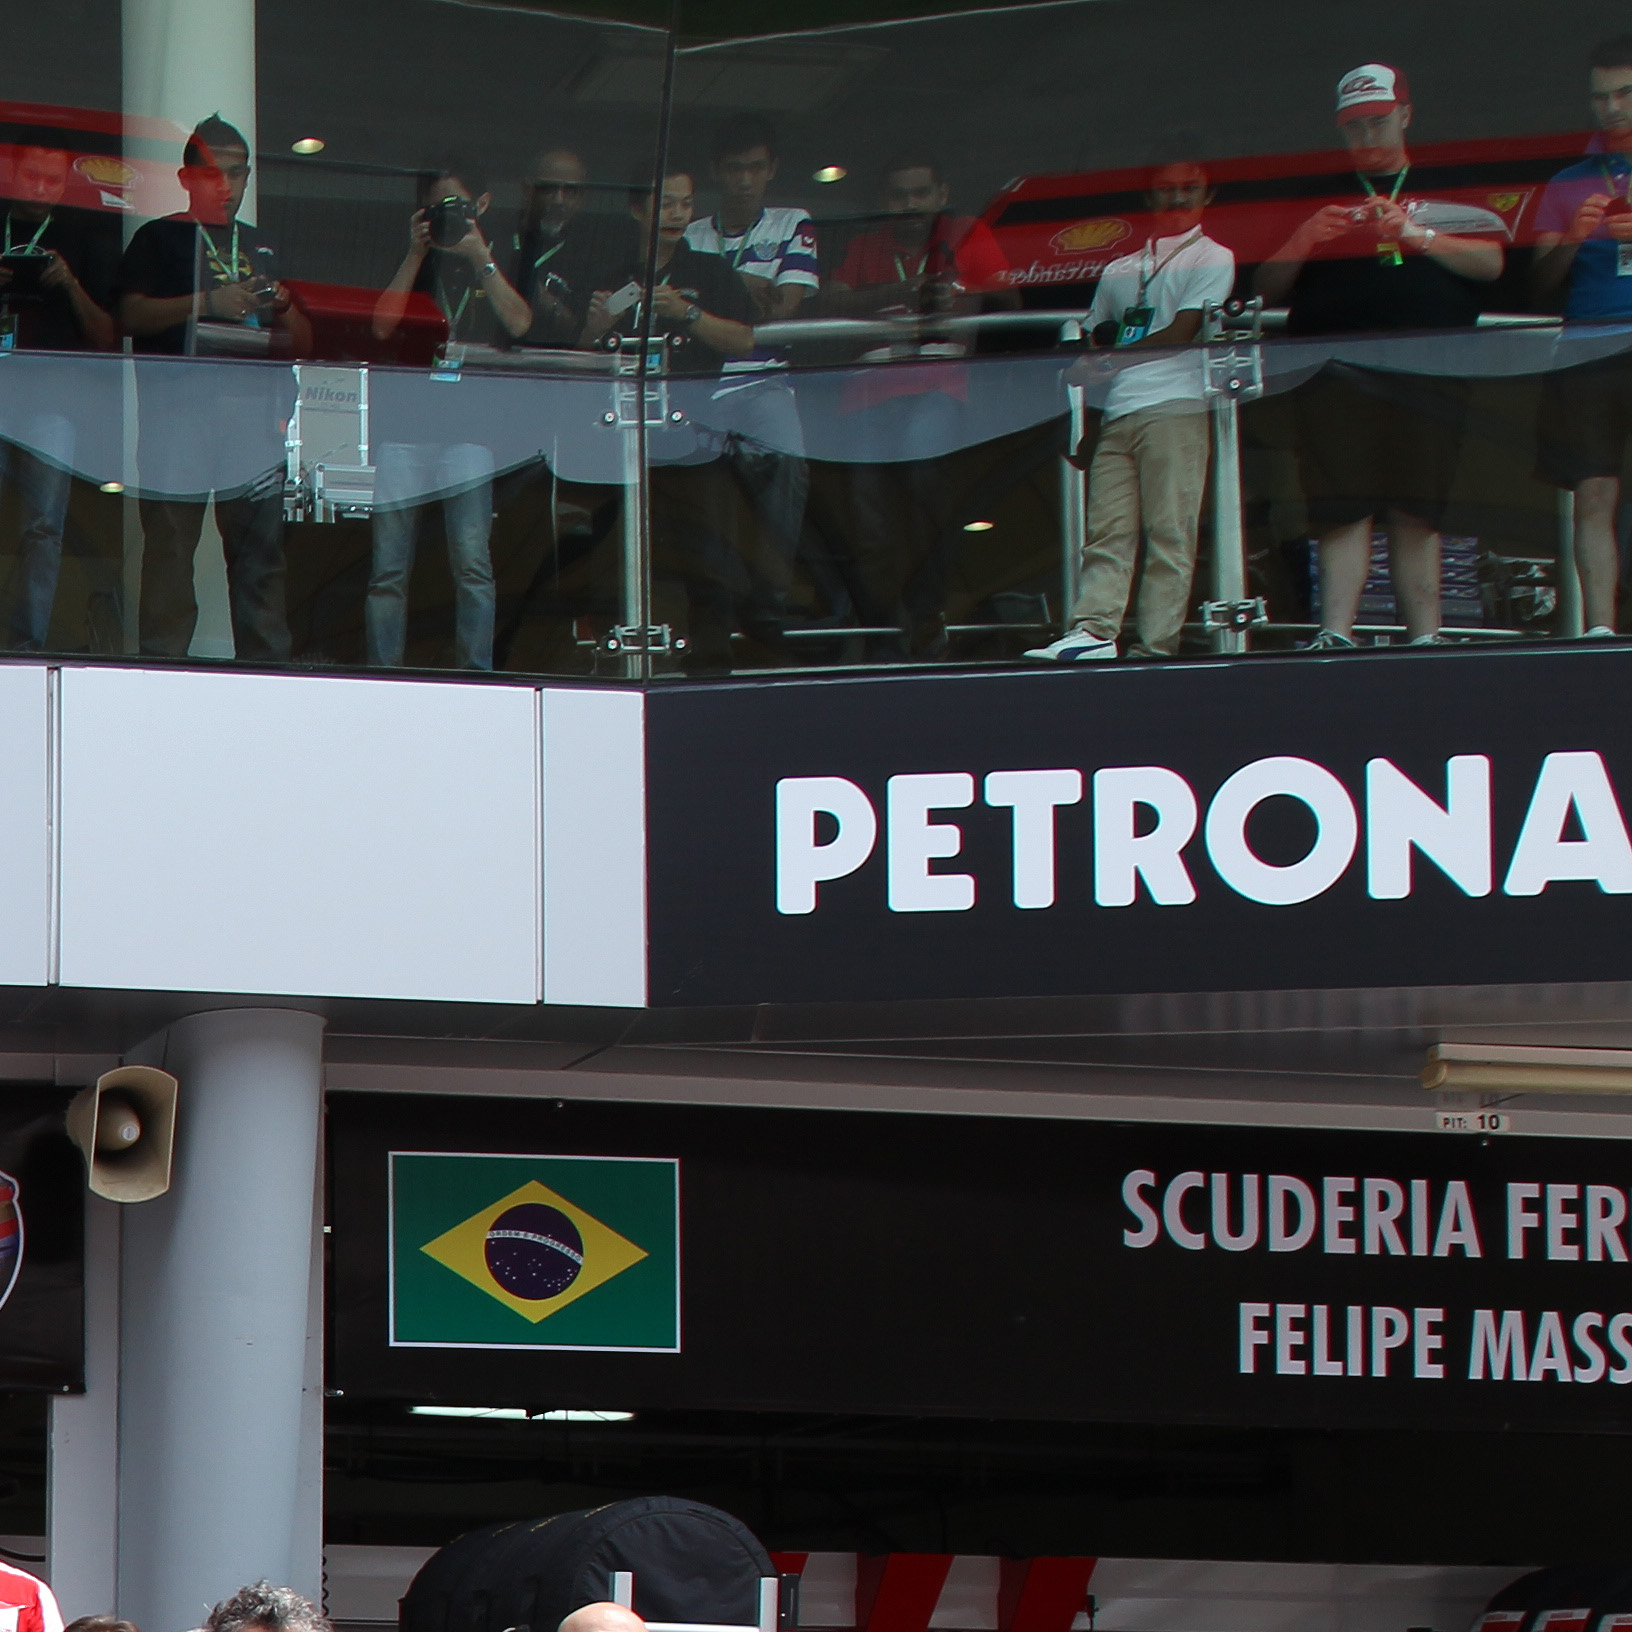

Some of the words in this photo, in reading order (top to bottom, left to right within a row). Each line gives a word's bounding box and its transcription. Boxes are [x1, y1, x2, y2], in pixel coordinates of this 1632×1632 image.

[304, 386, 358, 403] Nikon
[1477, 1113, 1500, 1130] 10
[1122, 1169, 1482, 1258] SCUDERIA
[1239, 1302, 1444, 1379] FELIPE
